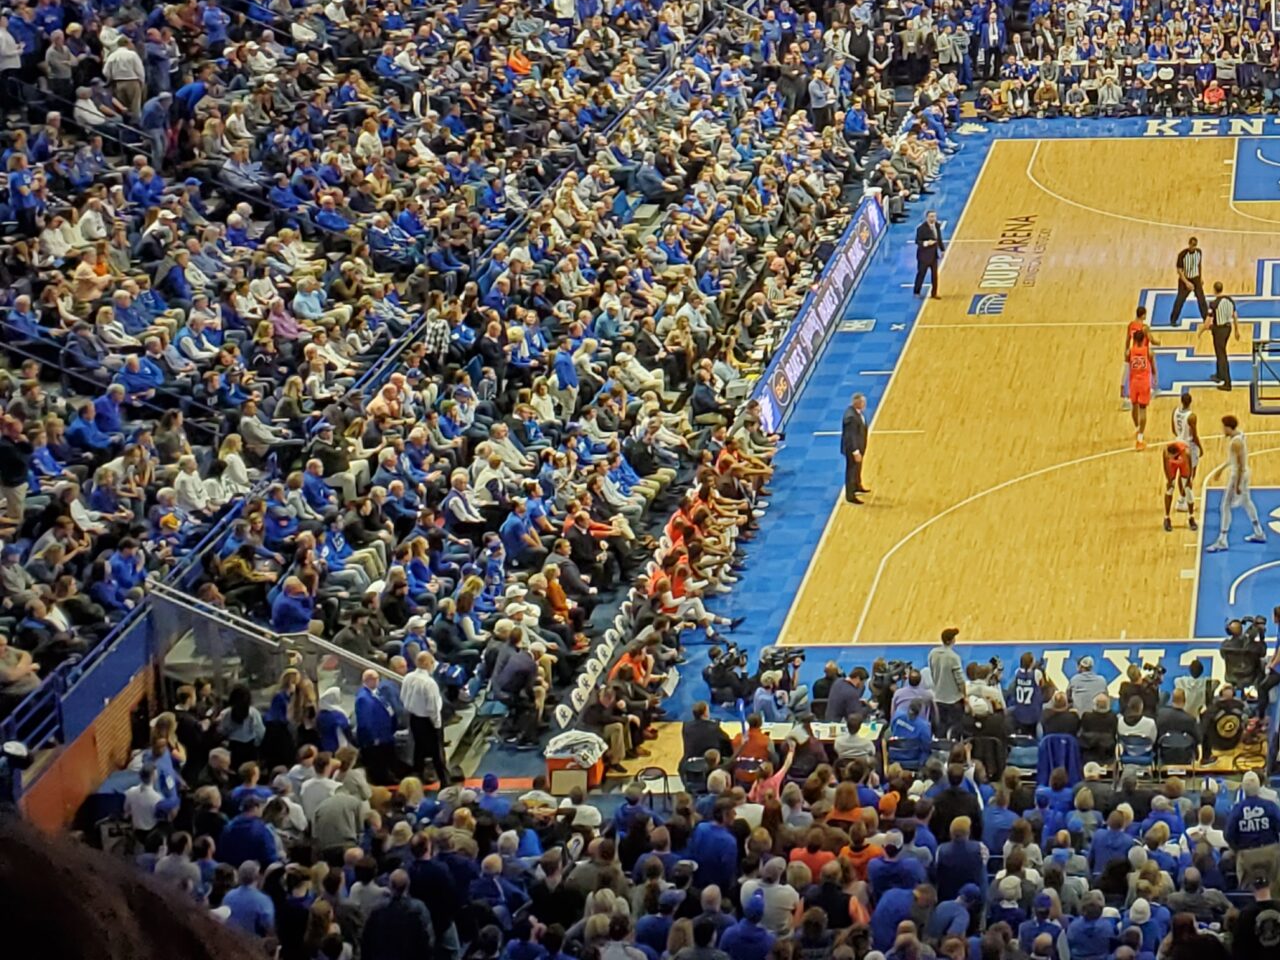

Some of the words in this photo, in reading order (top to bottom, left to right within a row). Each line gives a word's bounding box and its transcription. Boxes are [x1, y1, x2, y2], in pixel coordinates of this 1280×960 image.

[992, 214, 1038, 254] ARENA
[978, 254, 1024, 288] RUPP
[1132, 358, 1148, 369] 23
[1015, 687, 1034, 706] 07
[1242, 806, 1265, 818] GO
[1238, 817, 1270, 832] CATS
